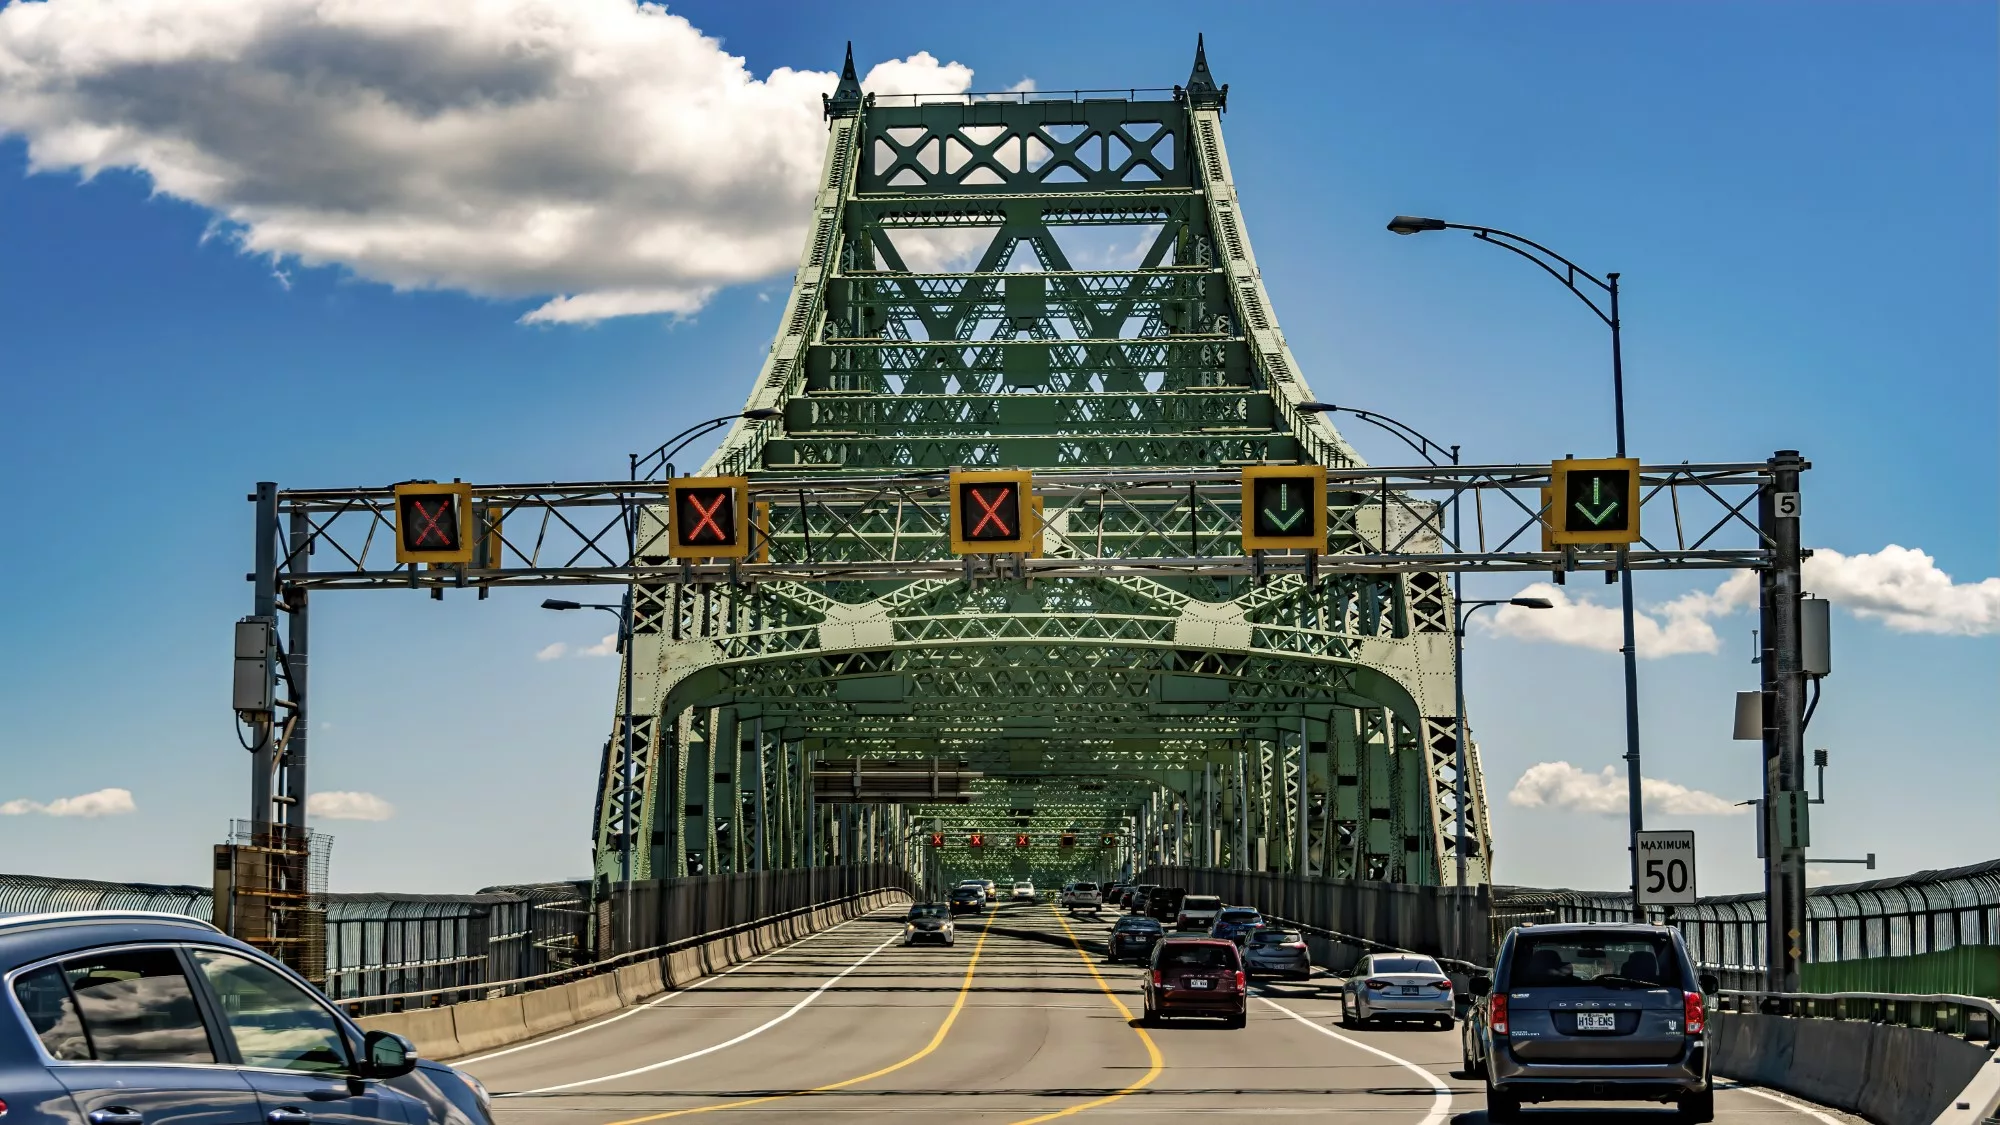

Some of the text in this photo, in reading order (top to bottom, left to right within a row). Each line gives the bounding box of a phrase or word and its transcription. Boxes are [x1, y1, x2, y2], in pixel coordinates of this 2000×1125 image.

[1780, 495, 1796, 514] 5
[1640, 840, 1691, 850] MAXIMUM
[1646, 858, 1688, 894] 50
